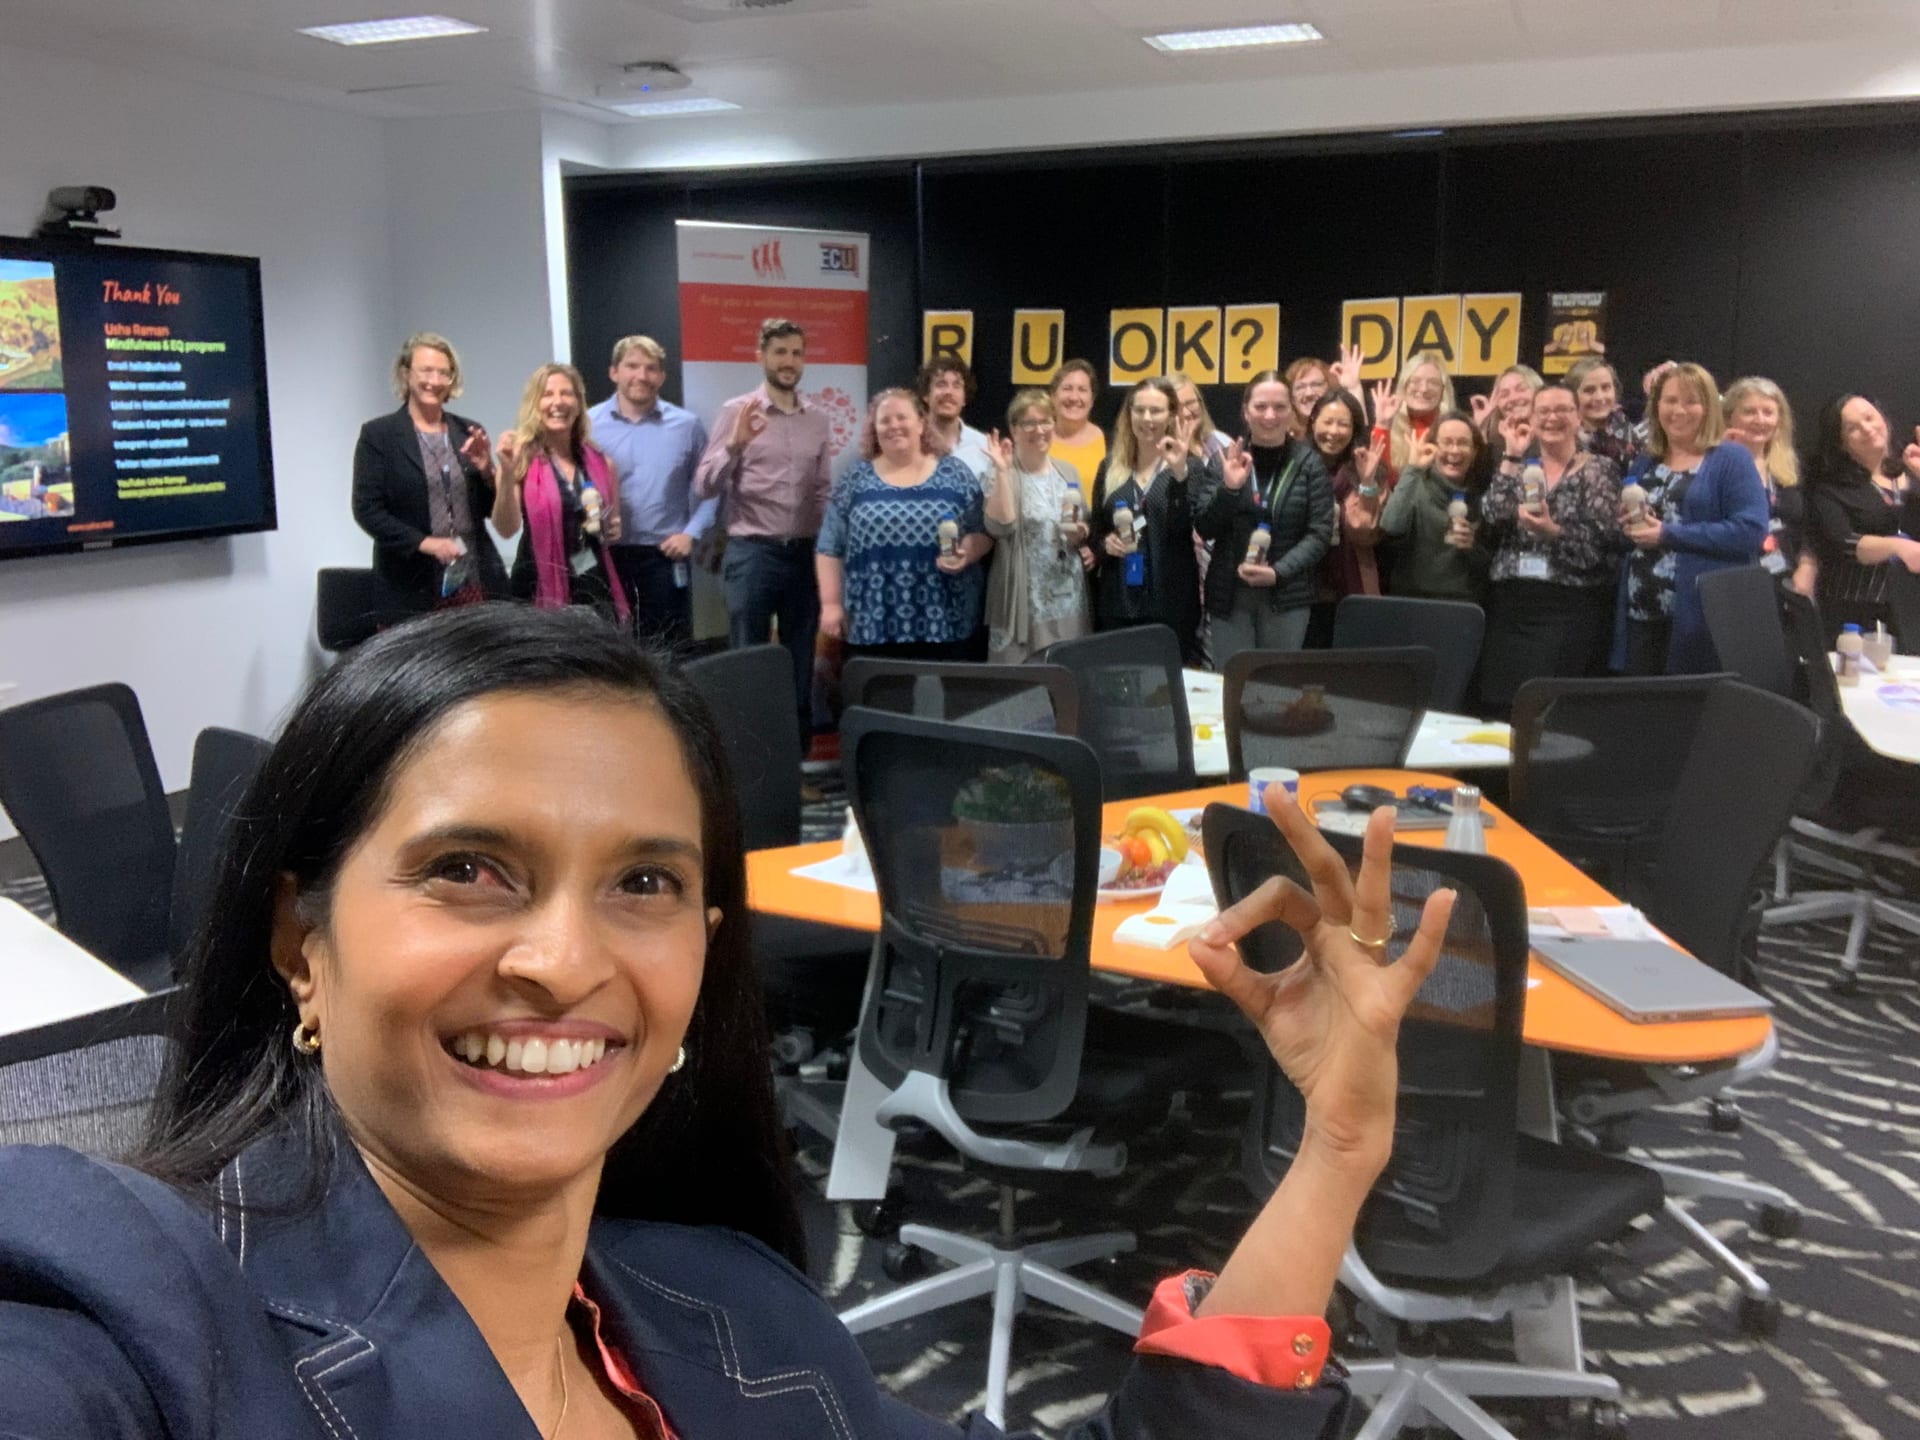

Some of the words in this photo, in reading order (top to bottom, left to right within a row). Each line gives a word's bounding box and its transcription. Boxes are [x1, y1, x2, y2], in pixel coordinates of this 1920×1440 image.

[820, 248, 855, 271] ECU
[102, 280, 151, 303] Thank
[156, 284, 181, 306] You
[105, 338, 161, 351] Mindfulness
[170, 339, 184, 353] EQ
[931, 324, 966, 361] R
[1020, 322, 1059, 371] U
[1112, 318, 1264, 373] OK?
[1351, 307, 1510, 364] DAY
